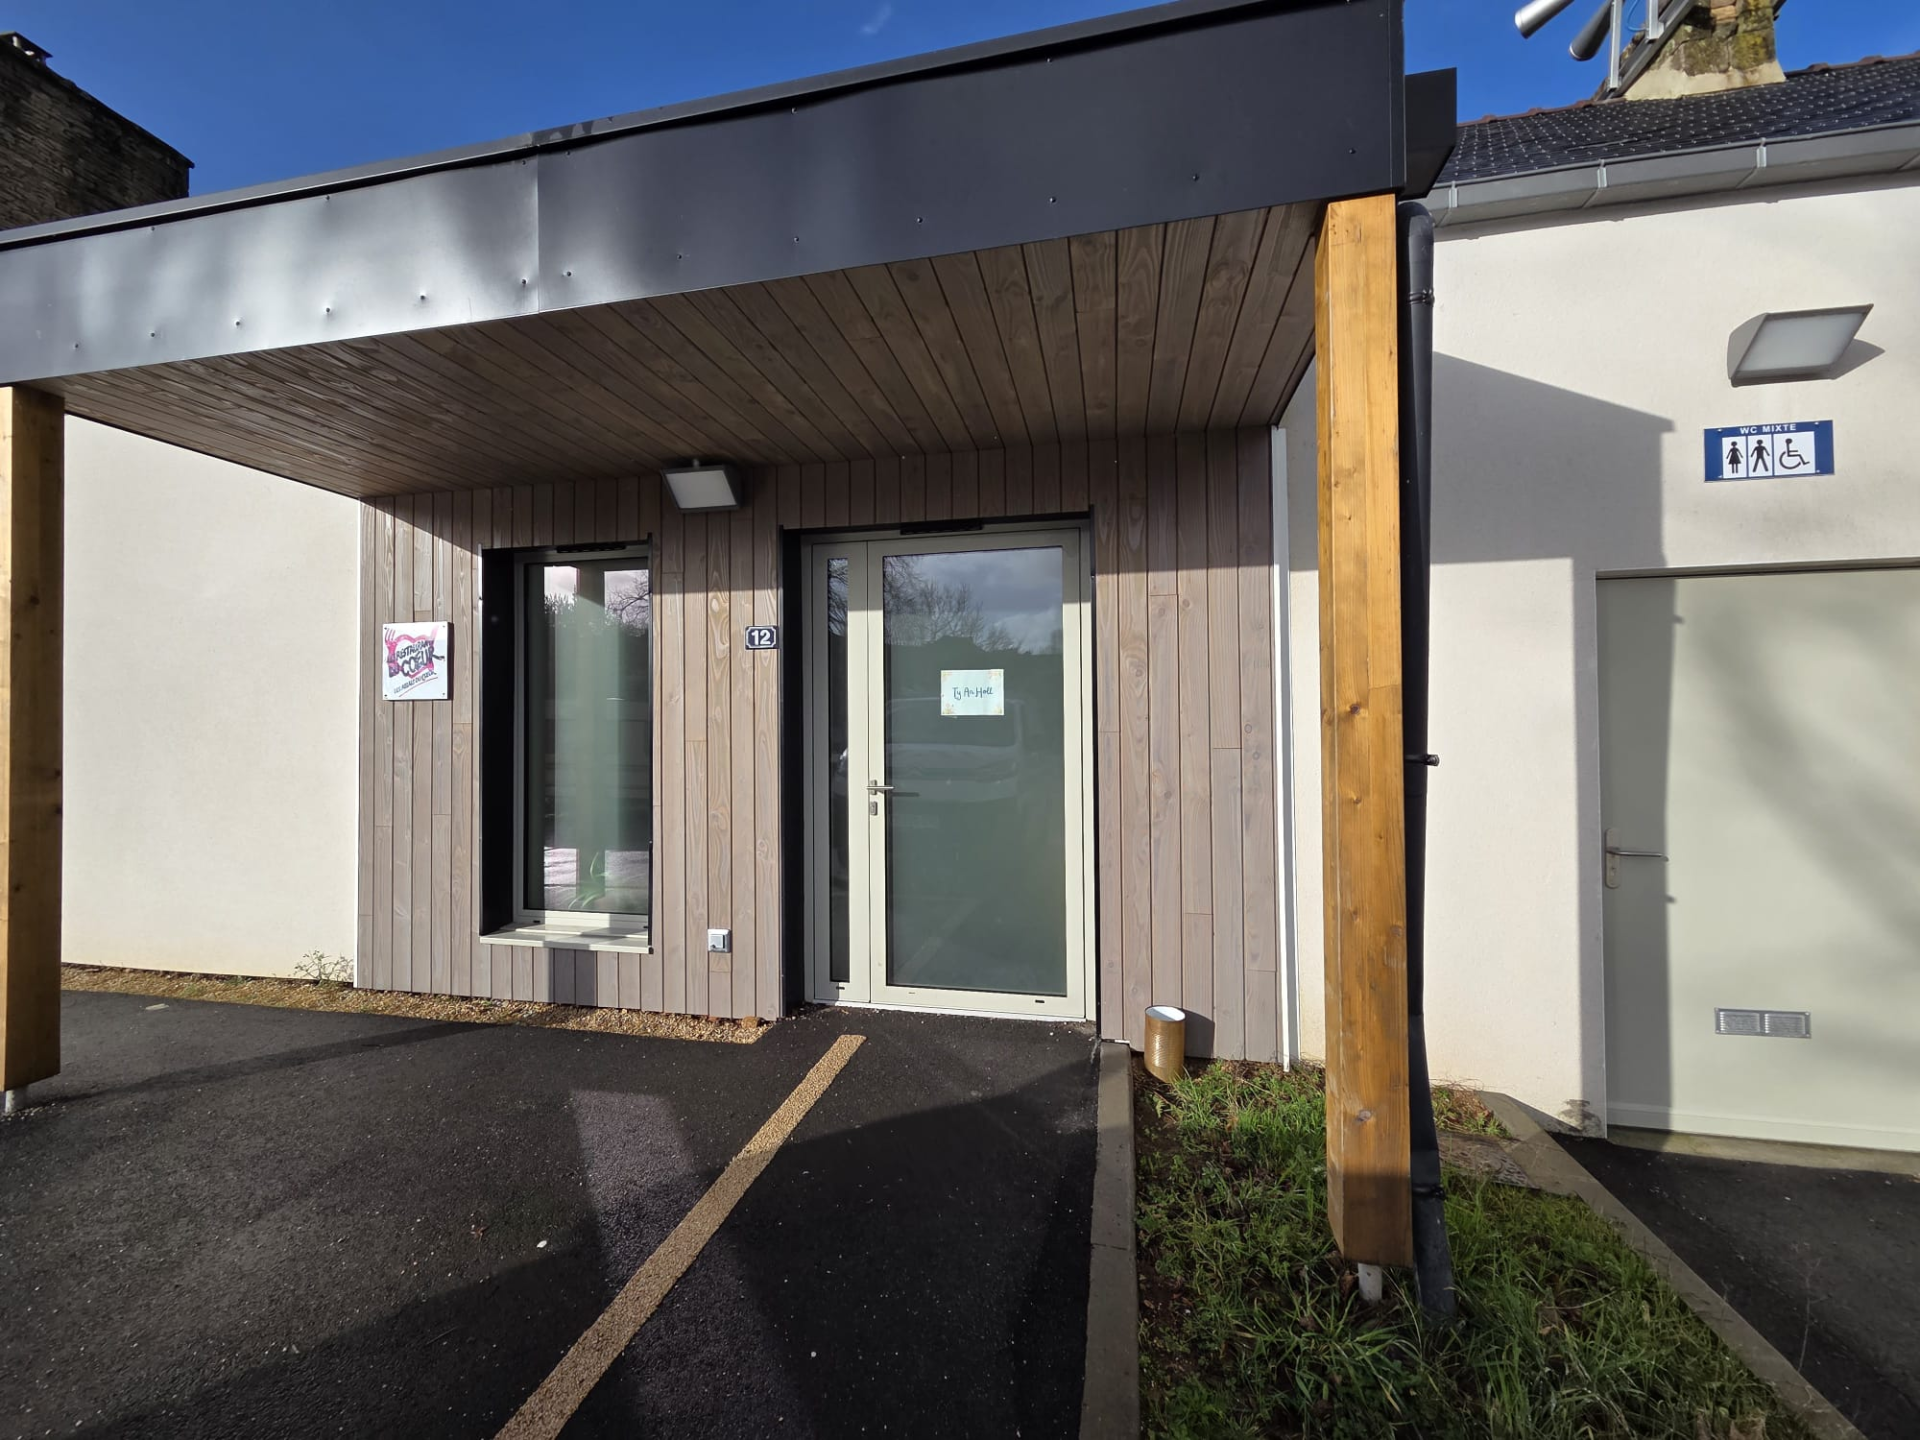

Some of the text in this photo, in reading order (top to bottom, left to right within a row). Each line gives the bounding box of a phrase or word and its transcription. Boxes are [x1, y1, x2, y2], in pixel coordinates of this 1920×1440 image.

[1740, 423, 1797, 435] WC MIXTE
[751, 629, 771, 646] 12
